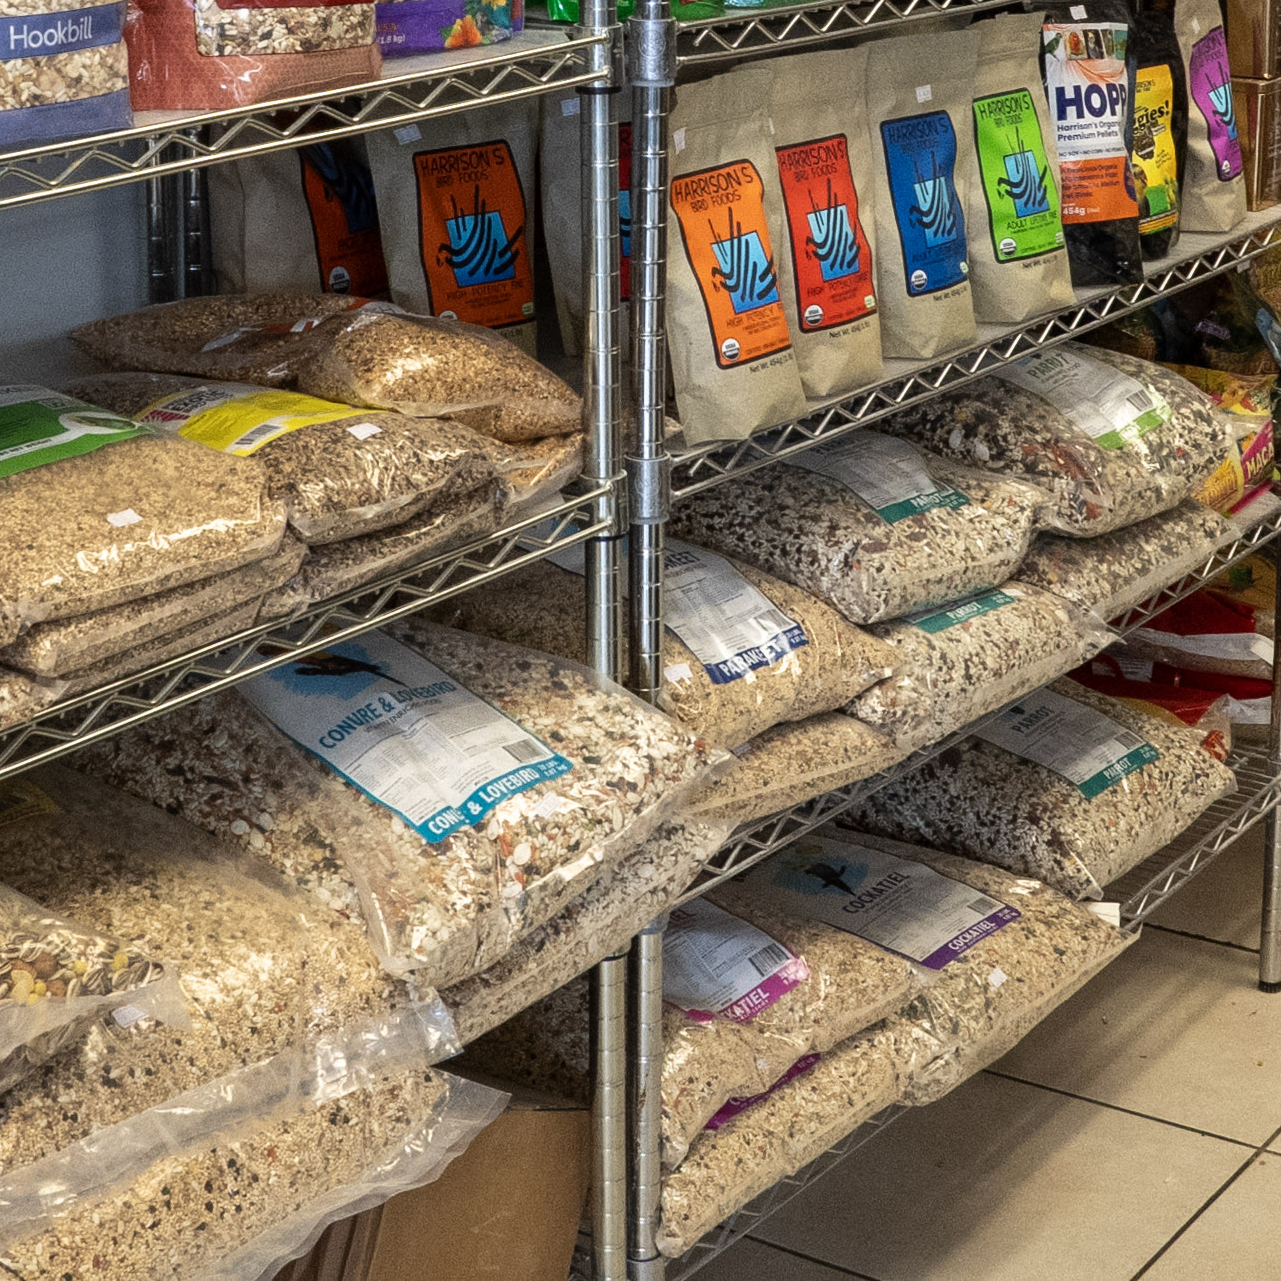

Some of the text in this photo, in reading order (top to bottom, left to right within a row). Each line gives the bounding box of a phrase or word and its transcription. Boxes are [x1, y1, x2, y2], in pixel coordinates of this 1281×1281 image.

[9, 15, 93, 51] Hookbill
[1057, 121, 1098, 133] Harrison's
[1057, 129, 1119, 142] Premium Pellets
[458, 171, 489, 184] FOODS
[793, 163, 838, 183] BIRD FOODS
[690, 190, 742, 213] BIRD FOODS
[1006, 219, 1027, 231] ADULT
[1026, 352, 1072, 379] PARROT
[171, 391, 220, 412] EXOTIC
[909, 492, 945, 508] PARROT
[946, 602, 983, 620] PARROT
[319, 681, 457, 750] CONURE & LOVEBIRD
[1010, 705, 1055, 734] PARROT
[1102, 758, 1133, 781] PARROT
[467, 769, 540, 816] & LOVEBIRD
[842, 871, 911, 915] COCKATIEL
[947, 919, 997, 951] COCKATIEL
[720, 987, 770, 1022] KATIEL
